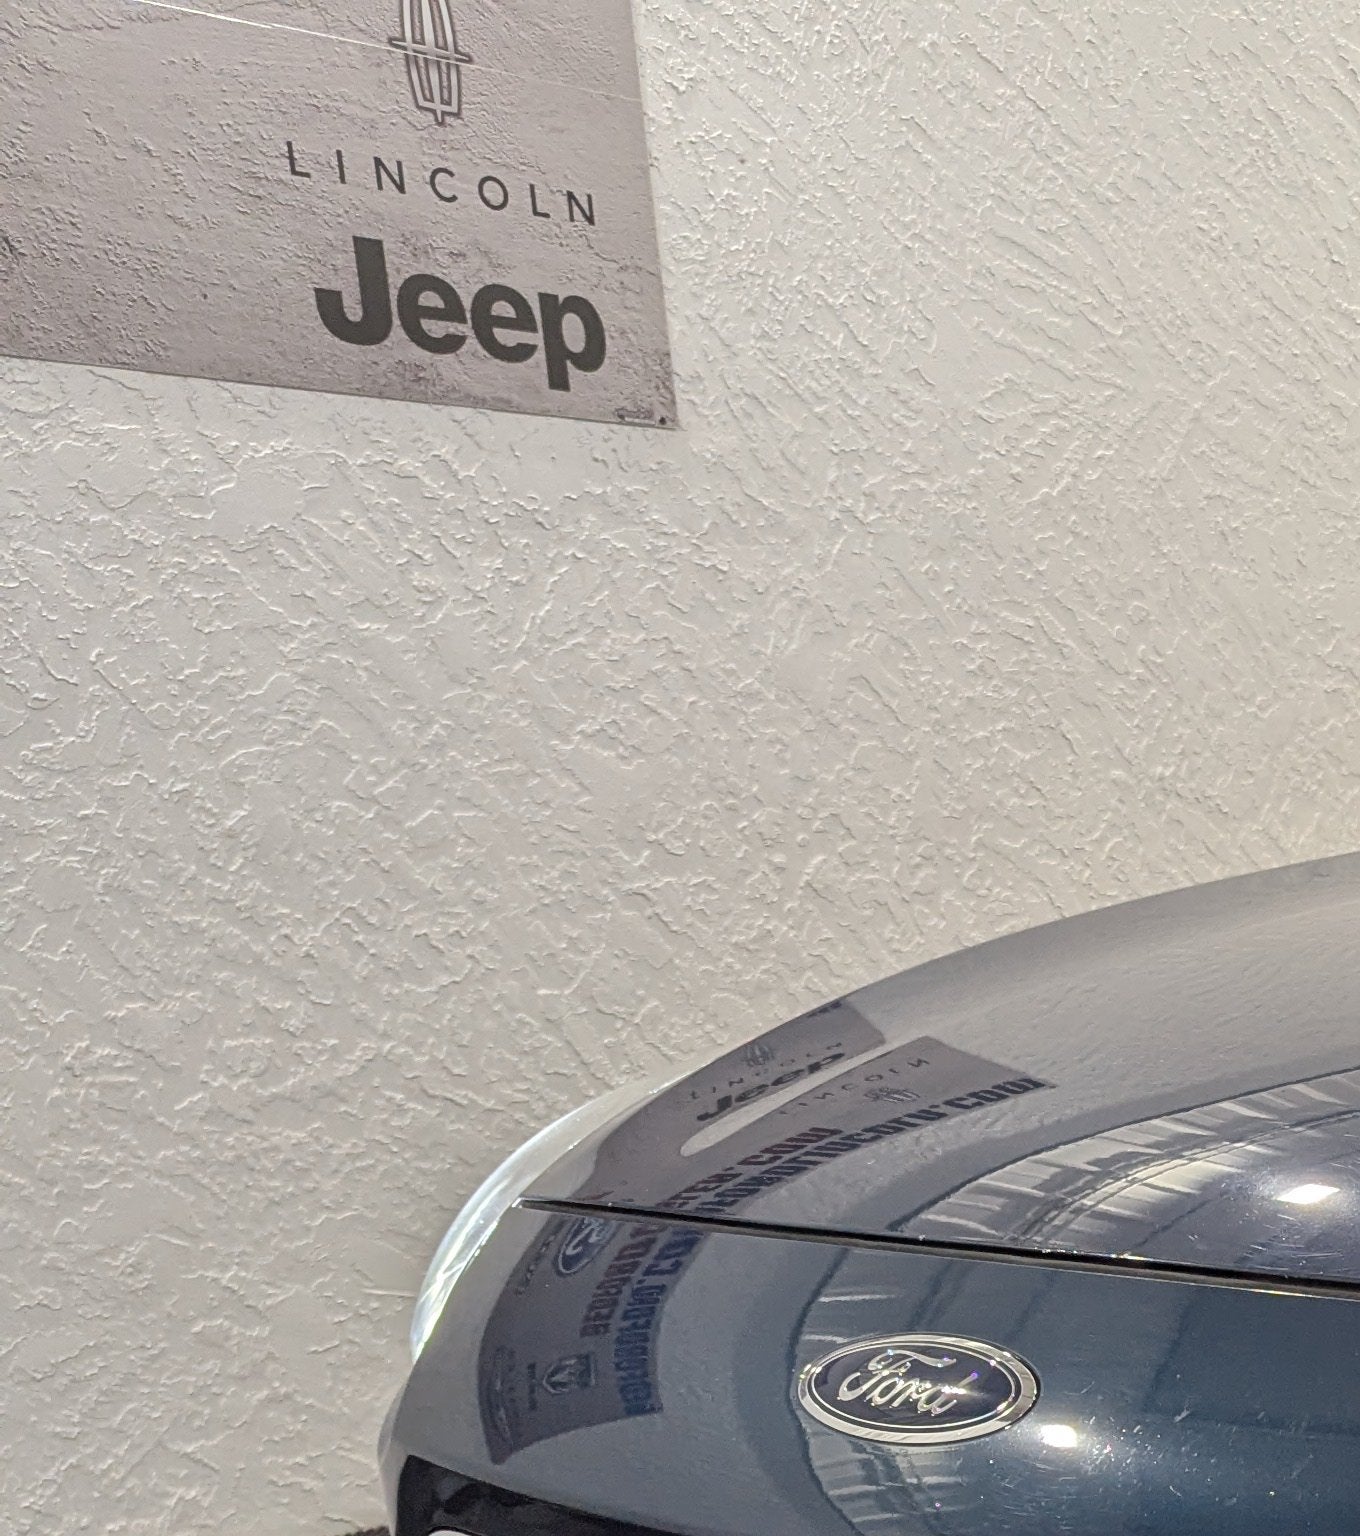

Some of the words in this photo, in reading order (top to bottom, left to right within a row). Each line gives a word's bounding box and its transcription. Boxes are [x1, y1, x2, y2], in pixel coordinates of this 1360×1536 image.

[286, 140, 596, 226] LINCOLN
[314, 235, 607, 392] Jeep
[696, 1052, 845, 1121] Jeep
[838, 1349, 975, 1417] Ford
